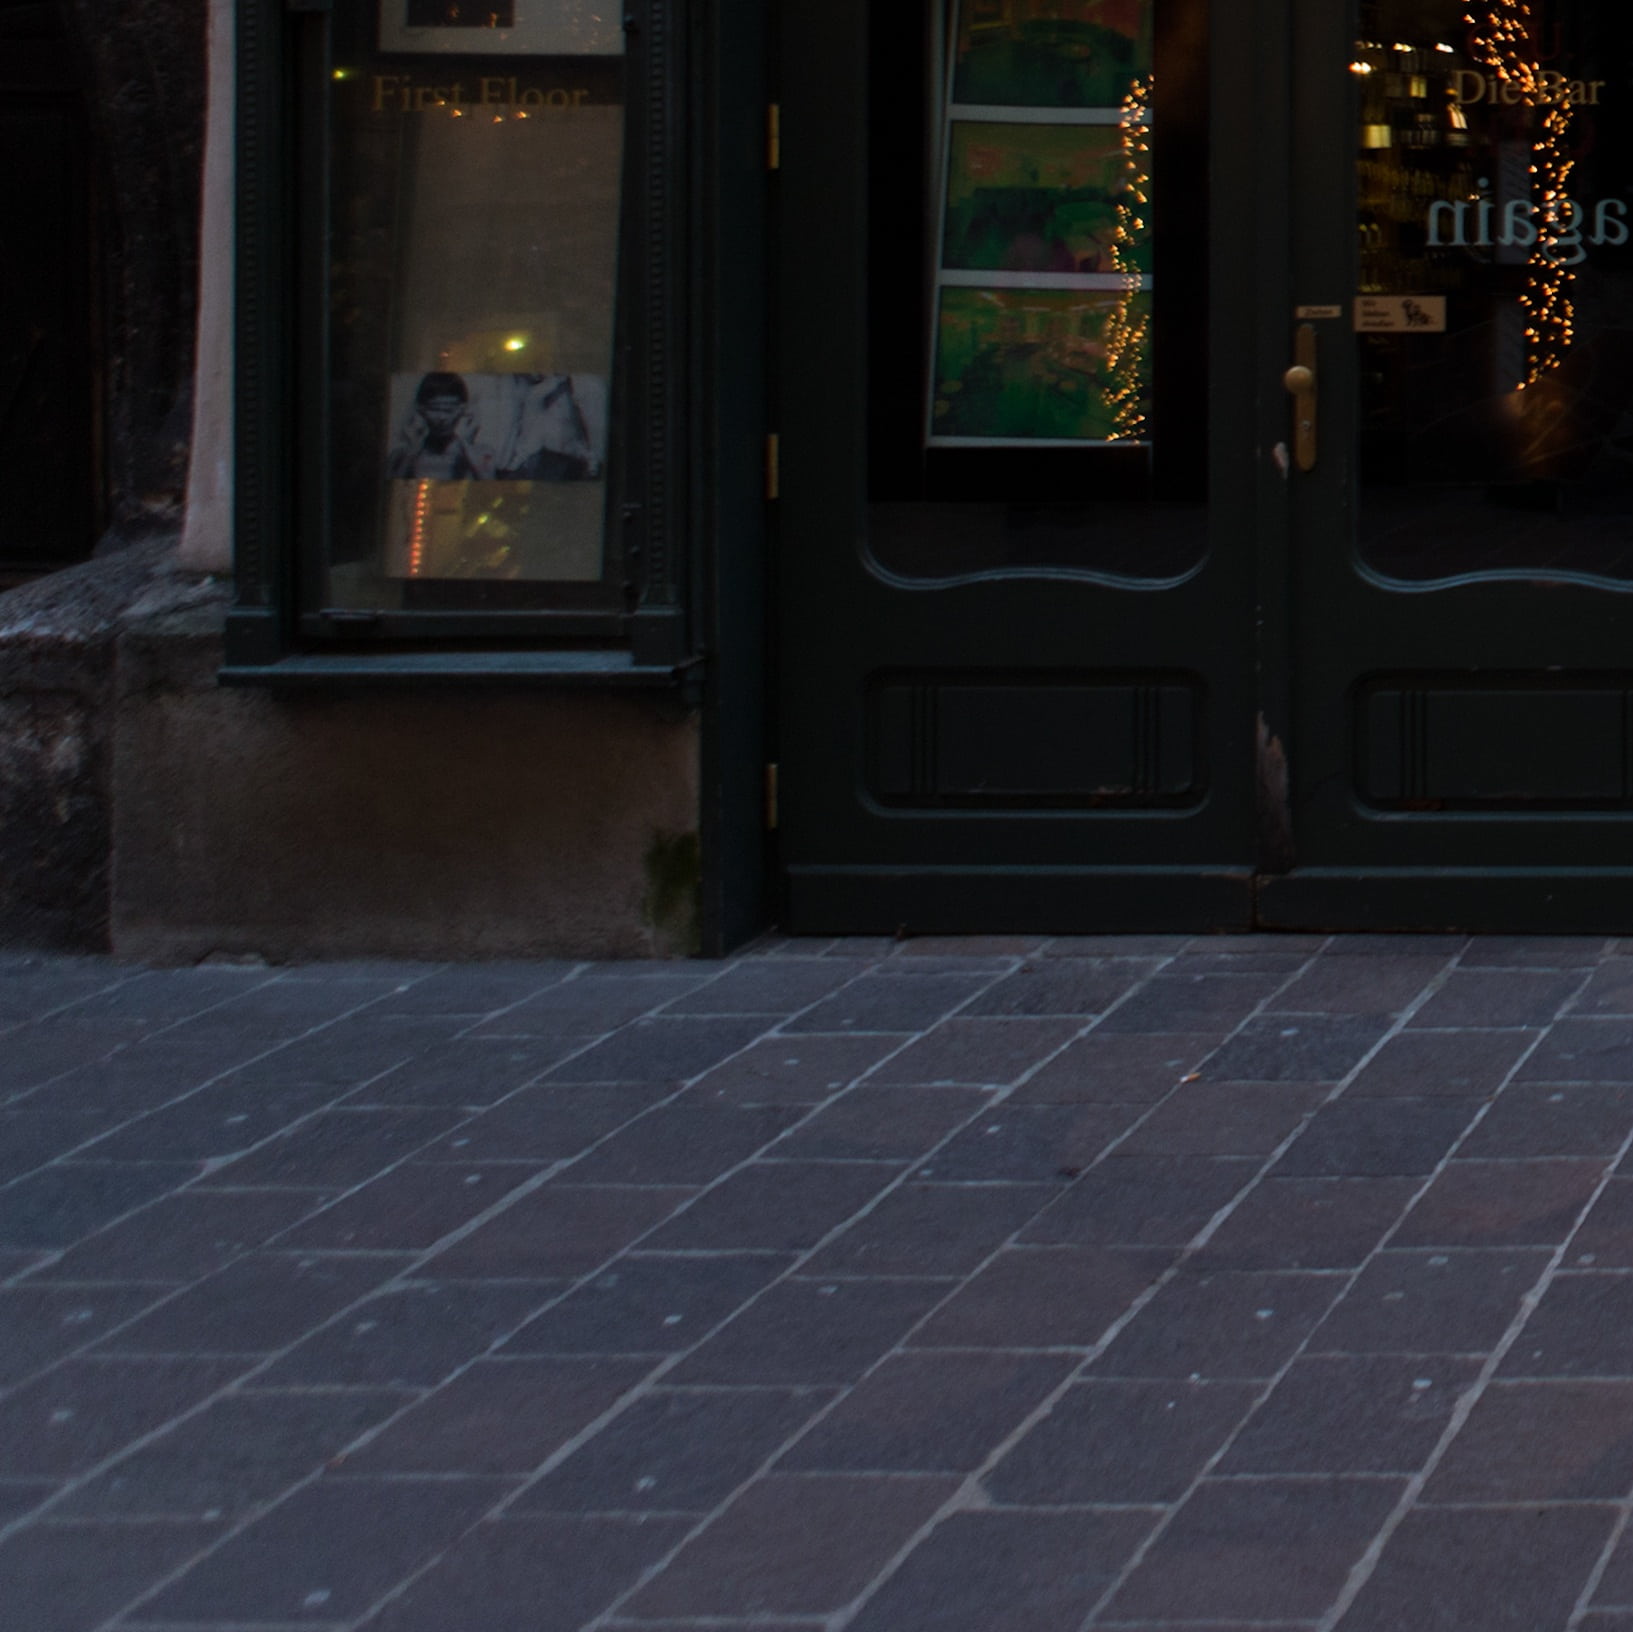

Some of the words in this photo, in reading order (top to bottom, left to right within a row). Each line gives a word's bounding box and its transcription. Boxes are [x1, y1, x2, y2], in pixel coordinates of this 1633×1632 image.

[371, 73, 464, 111] First
[480, 76, 590, 111] Floor
[1454, 69, 1523, 105] Die
[1537, 69, 1607, 105] Bar
